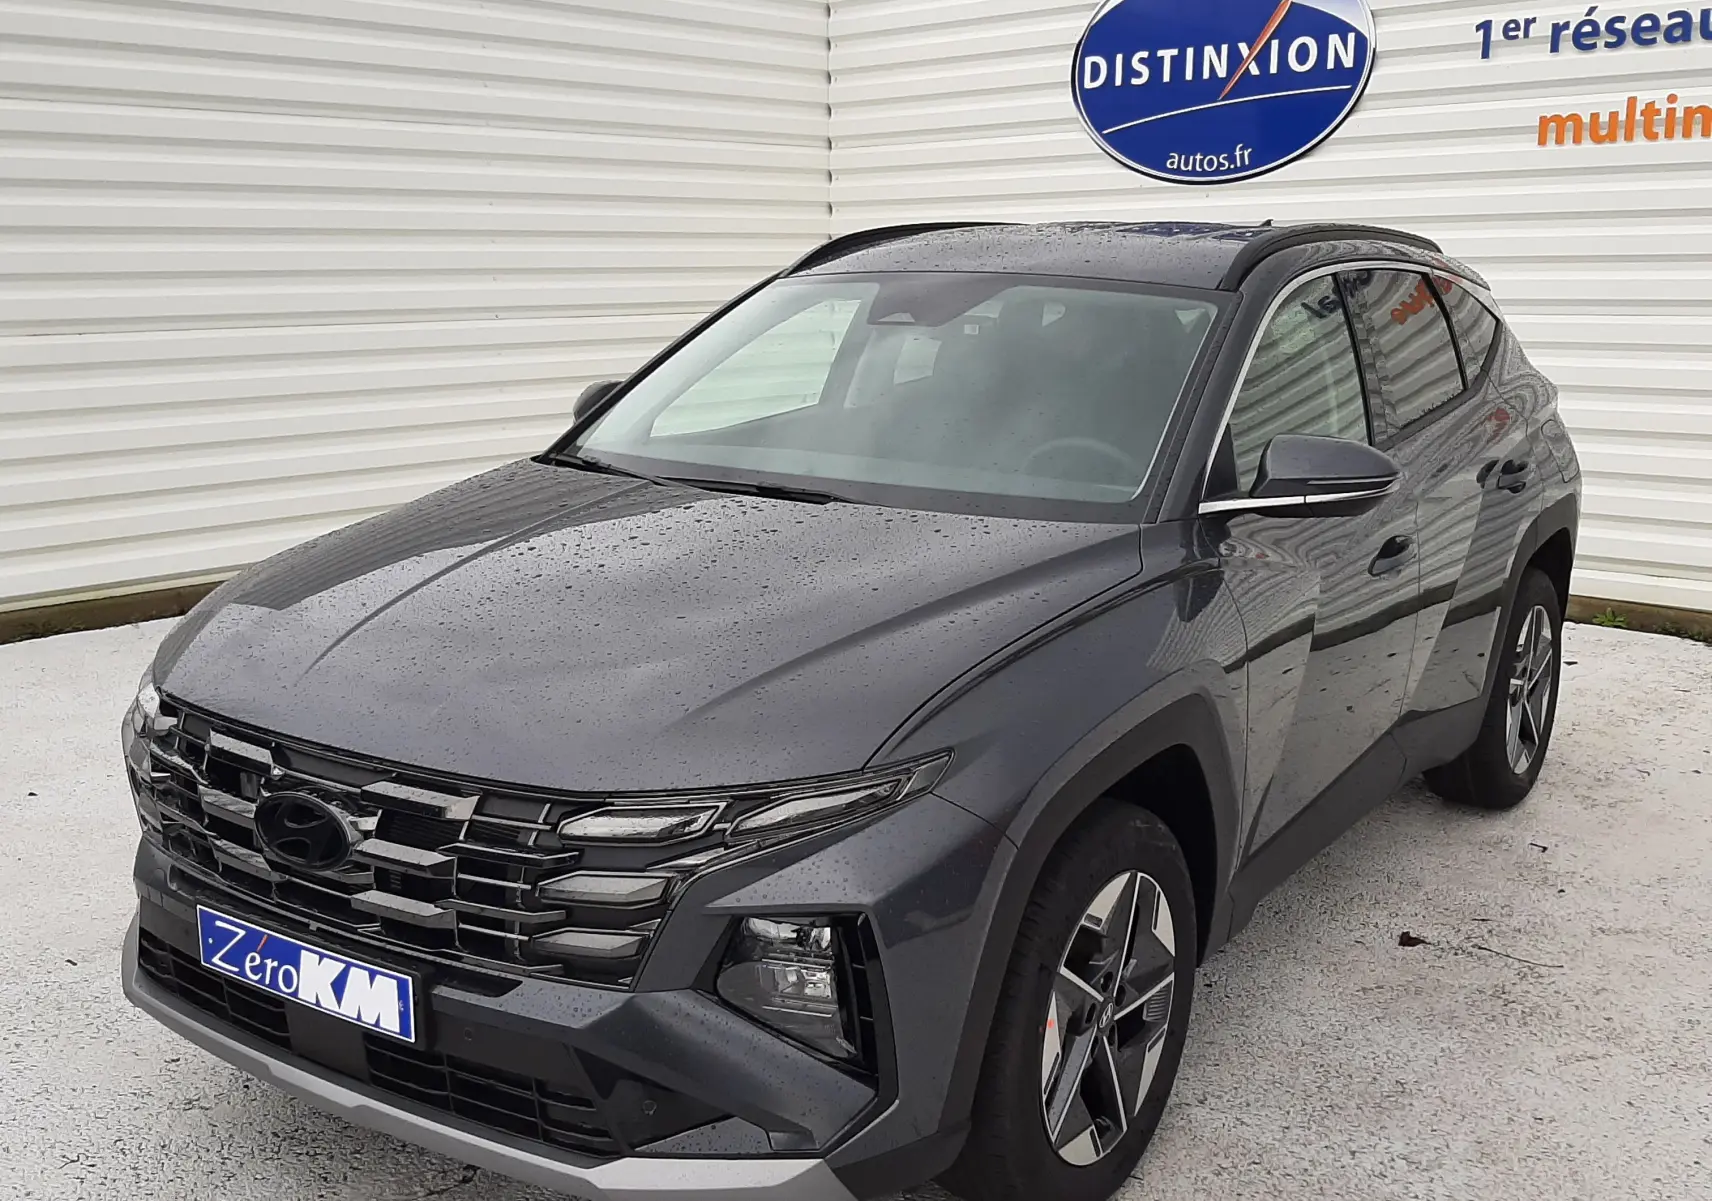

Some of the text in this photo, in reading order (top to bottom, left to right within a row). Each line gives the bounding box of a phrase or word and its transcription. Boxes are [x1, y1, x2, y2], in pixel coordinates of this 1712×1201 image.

[1475, 16, 1537, 60] 1er
[1083, 31, 1356, 90] DISTINXION
[1166, 144, 1253, 172] autos.fr
